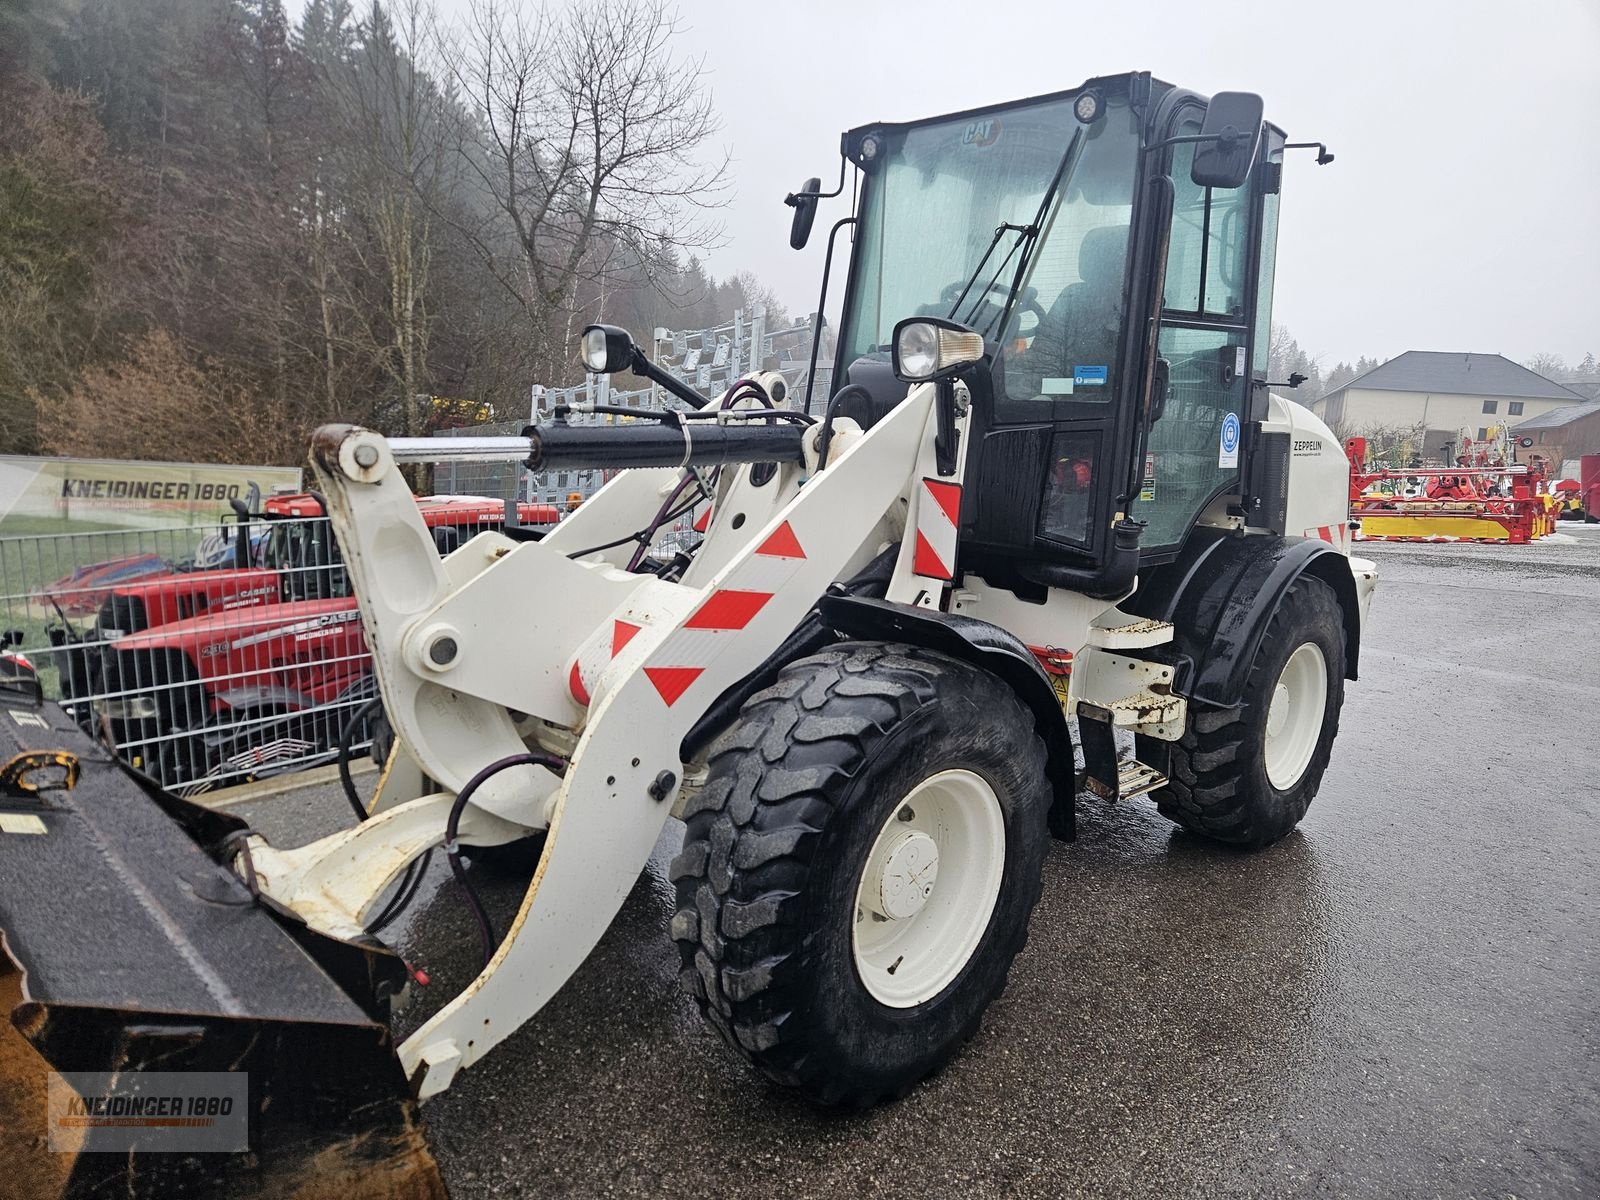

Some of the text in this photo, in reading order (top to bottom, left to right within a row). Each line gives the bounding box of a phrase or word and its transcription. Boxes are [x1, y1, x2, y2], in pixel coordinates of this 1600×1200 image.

[962, 119, 994, 145] CAT
[1293, 440, 1322, 451] ZEPPELIN
[62, 479, 240, 501] KNEIDINGER 1880
